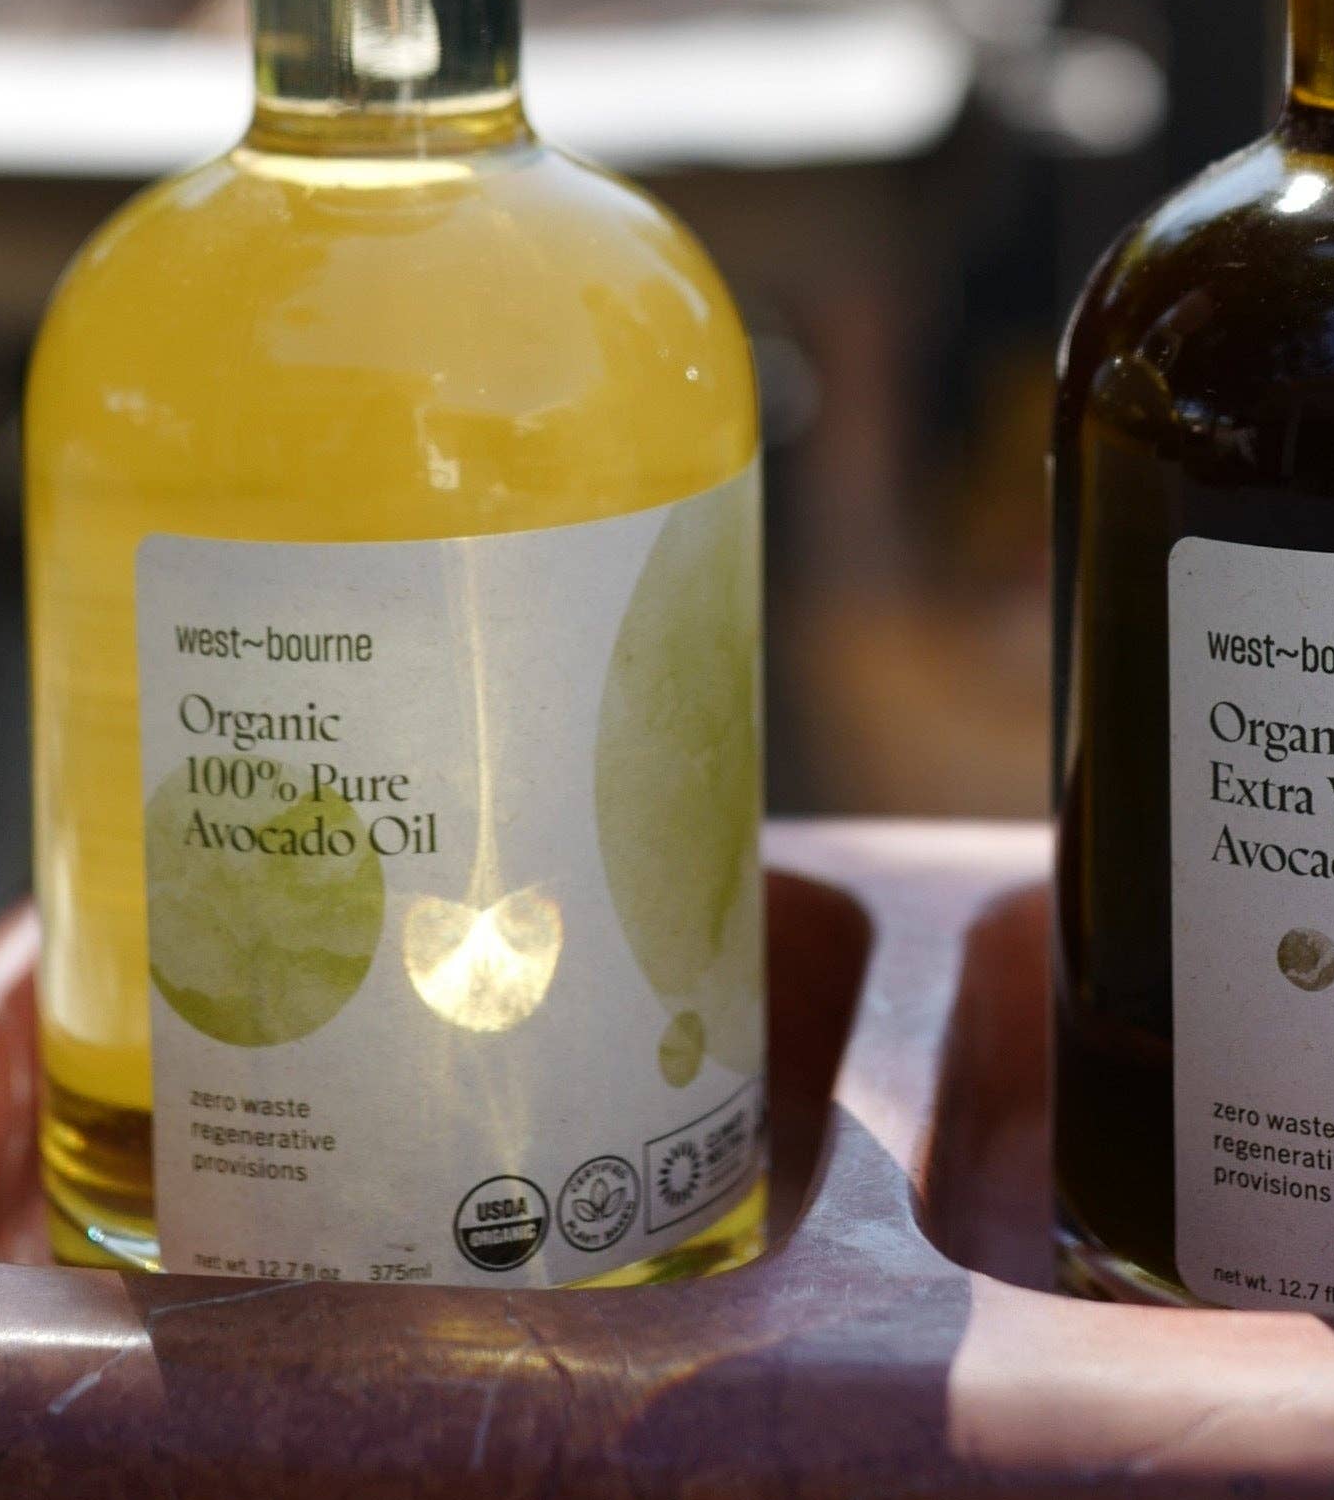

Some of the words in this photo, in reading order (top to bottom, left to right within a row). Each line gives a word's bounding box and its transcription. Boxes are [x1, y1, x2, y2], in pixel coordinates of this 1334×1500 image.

[179, 693, 341, 751] Organic
[186, 755, 298, 802] 100%
[310, 762, 410, 802] Pure
[1209, 760, 1315, 816] Extra
[183, 808, 356, 857] Avocado
[369, 813, 439, 856] Oil
[189, 1089, 236, 1112] zero
[241, 1097, 312, 1119] waste
[1213, 1102, 1260, 1127] zero
[190, 1121, 337, 1152] regenerative
[192, 1153, 308, 1182] provisions
[1213, 1165, 1332, 1203] provisions
[476, 1197, 529, 1222] USDA
[369, 1262, 433, 1282] 375ml
[1213, 1266, 1242, 1287] net
[1246, 1274, 1272, 1293] wt.
[1279, 1278, 1319, 1301] 12.7
